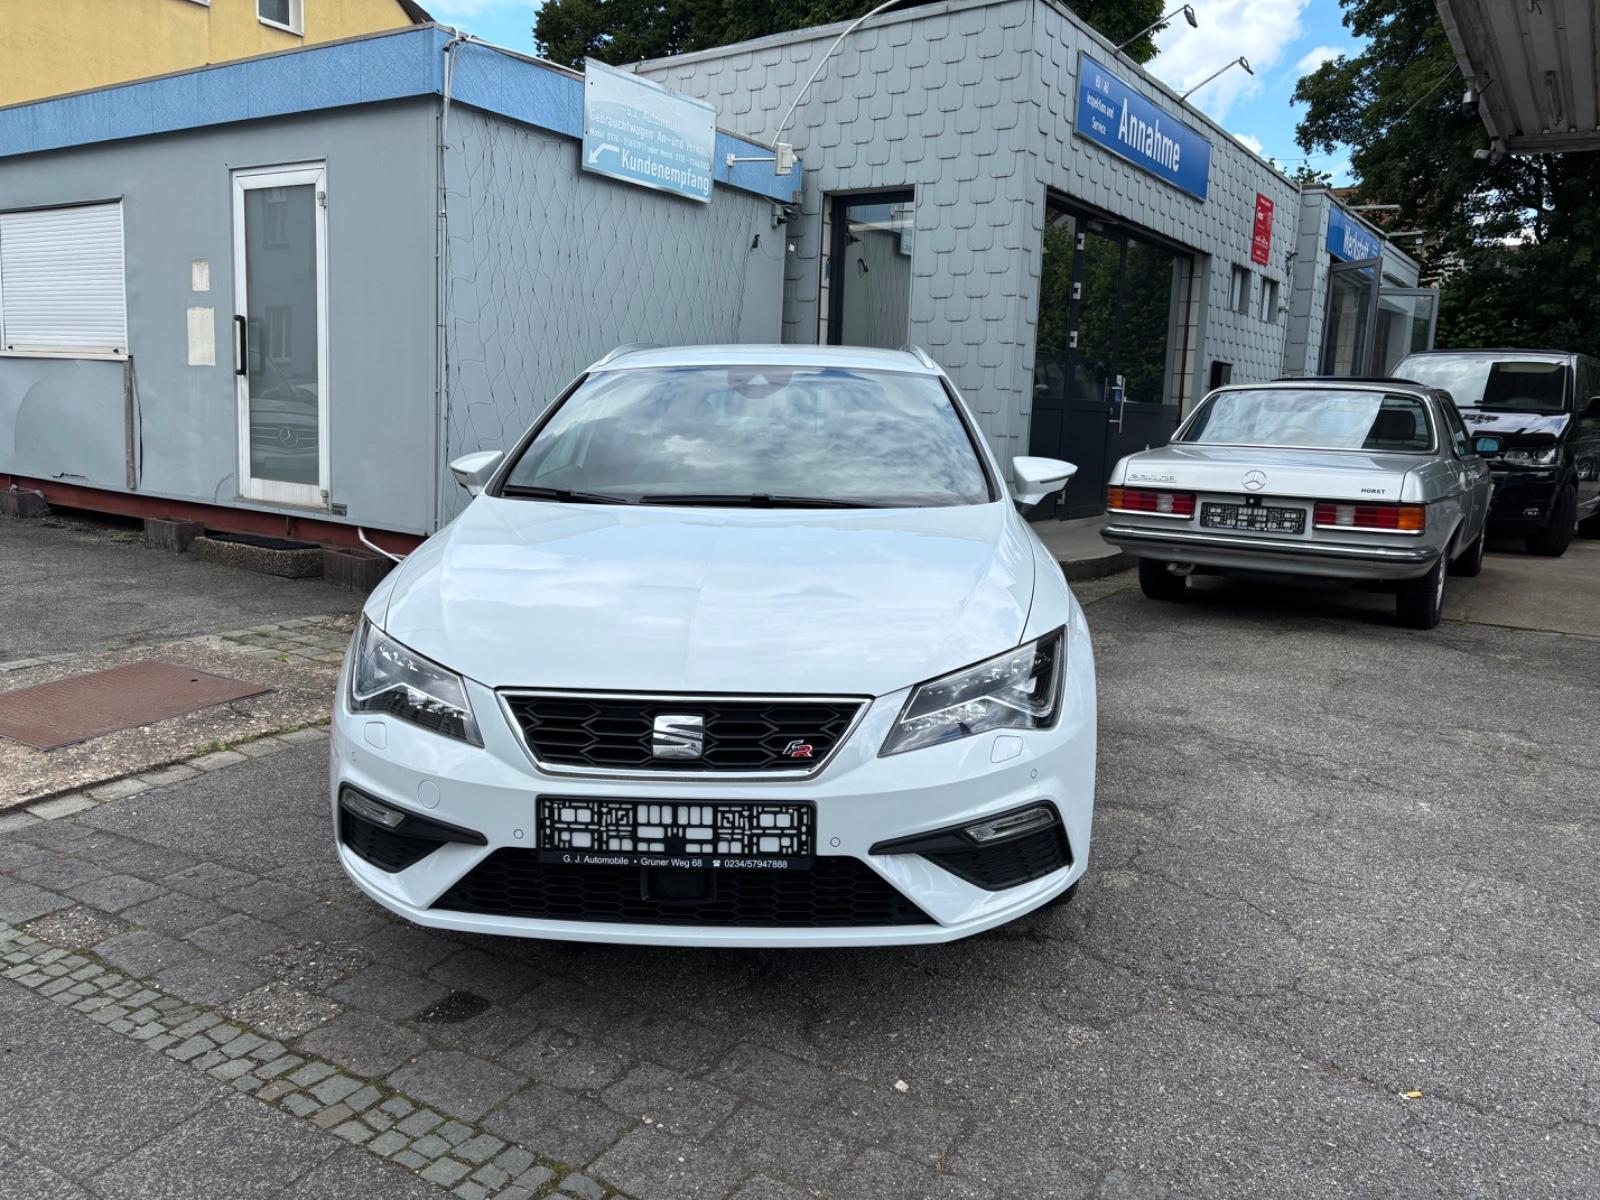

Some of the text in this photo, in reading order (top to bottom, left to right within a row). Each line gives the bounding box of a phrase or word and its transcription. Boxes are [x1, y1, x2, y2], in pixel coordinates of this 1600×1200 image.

[590, 107, 653, 140] Gebrauchtwagen
[1118, 97, 1180, 172] Annahme
[621, 149, 709, 195] Kundenempfang
[1343, 224, 1368, 260] Werkstatt
[563, 854, 573, 863] G.
[574, 855, 581, 863] J.
[583, 855, 629, 865] Automobile
[670, 858, 690, 868] Weg
[691, 858, 703, 867] 68
[724, 859, 788, 868] 0234/57947888
